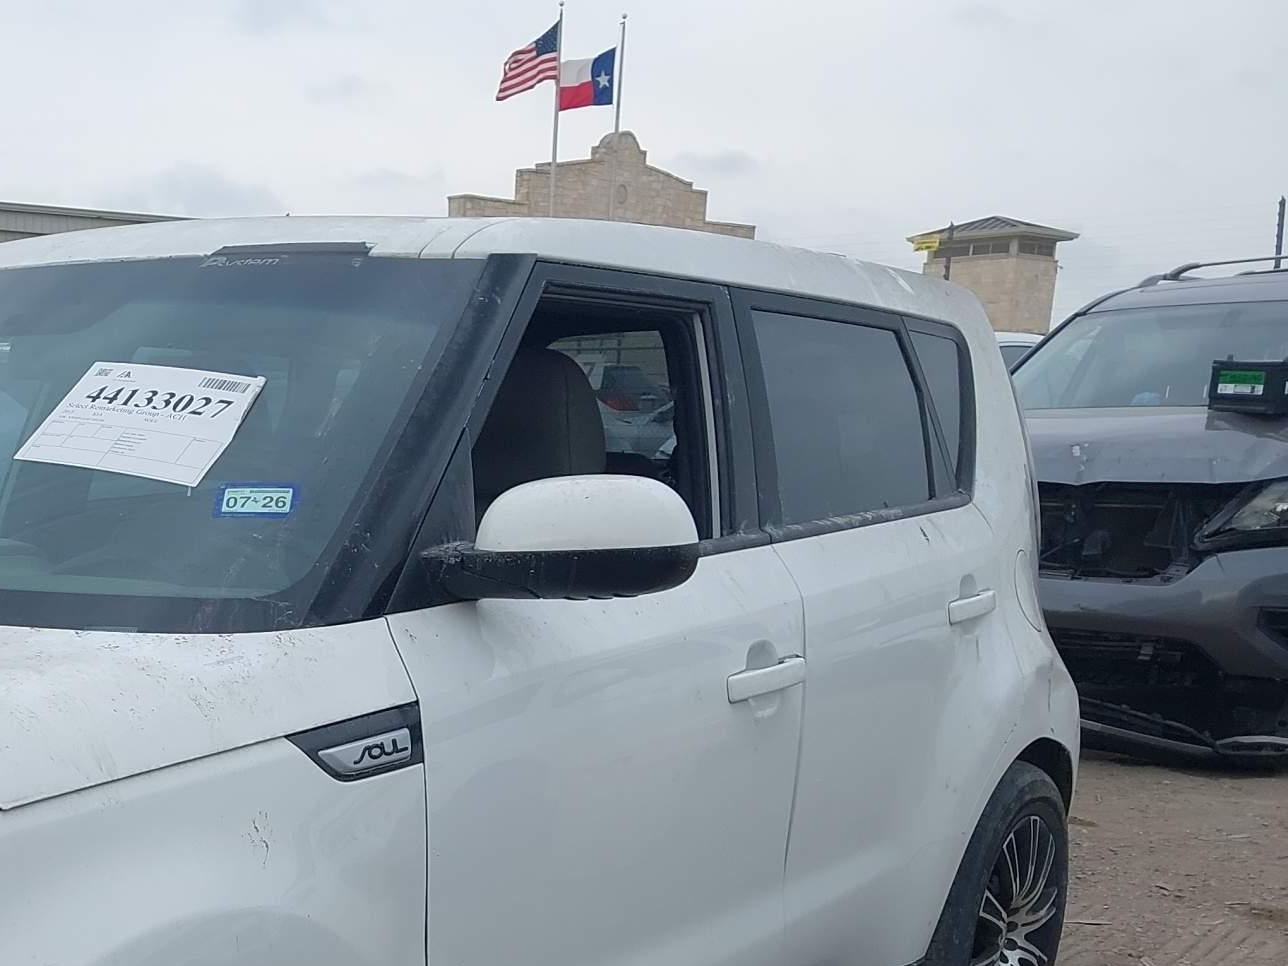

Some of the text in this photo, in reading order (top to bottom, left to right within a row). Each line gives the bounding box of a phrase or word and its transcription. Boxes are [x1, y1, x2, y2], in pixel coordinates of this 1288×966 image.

[85, 385, 234, 419] 44133027
[225, 495, 288, 509] 07 26
[353, 738, 409, 765] SOUL
